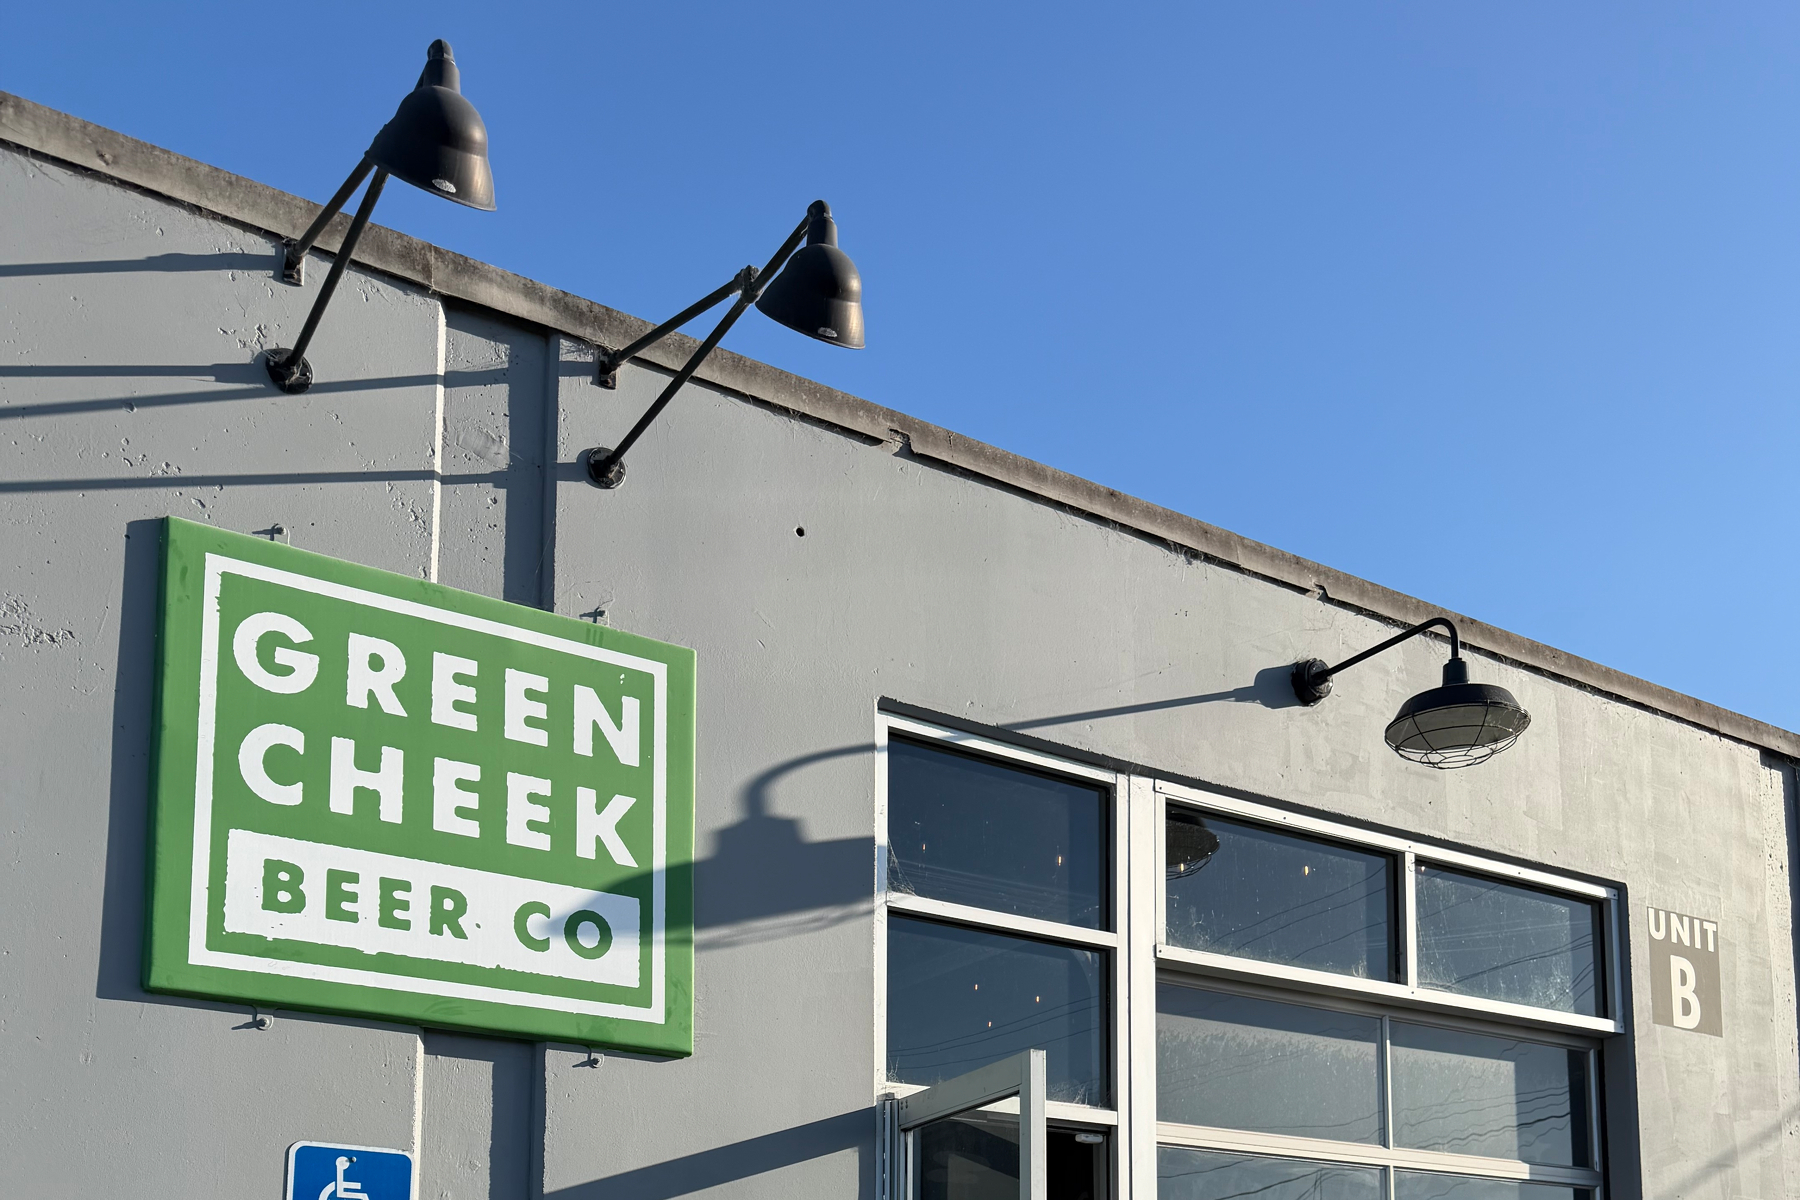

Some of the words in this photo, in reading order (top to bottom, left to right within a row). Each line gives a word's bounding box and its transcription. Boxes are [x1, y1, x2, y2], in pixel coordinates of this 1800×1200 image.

[232, 611, 640, 767] GREEN
[238, 722, 639, 868] CHEEK
[261, 858, 469, 941] BEER
[514, 900, 613, 960] CO
[1648, 908, 1716, 952] UNIT
[1670, 954, 1700, 1029] B
